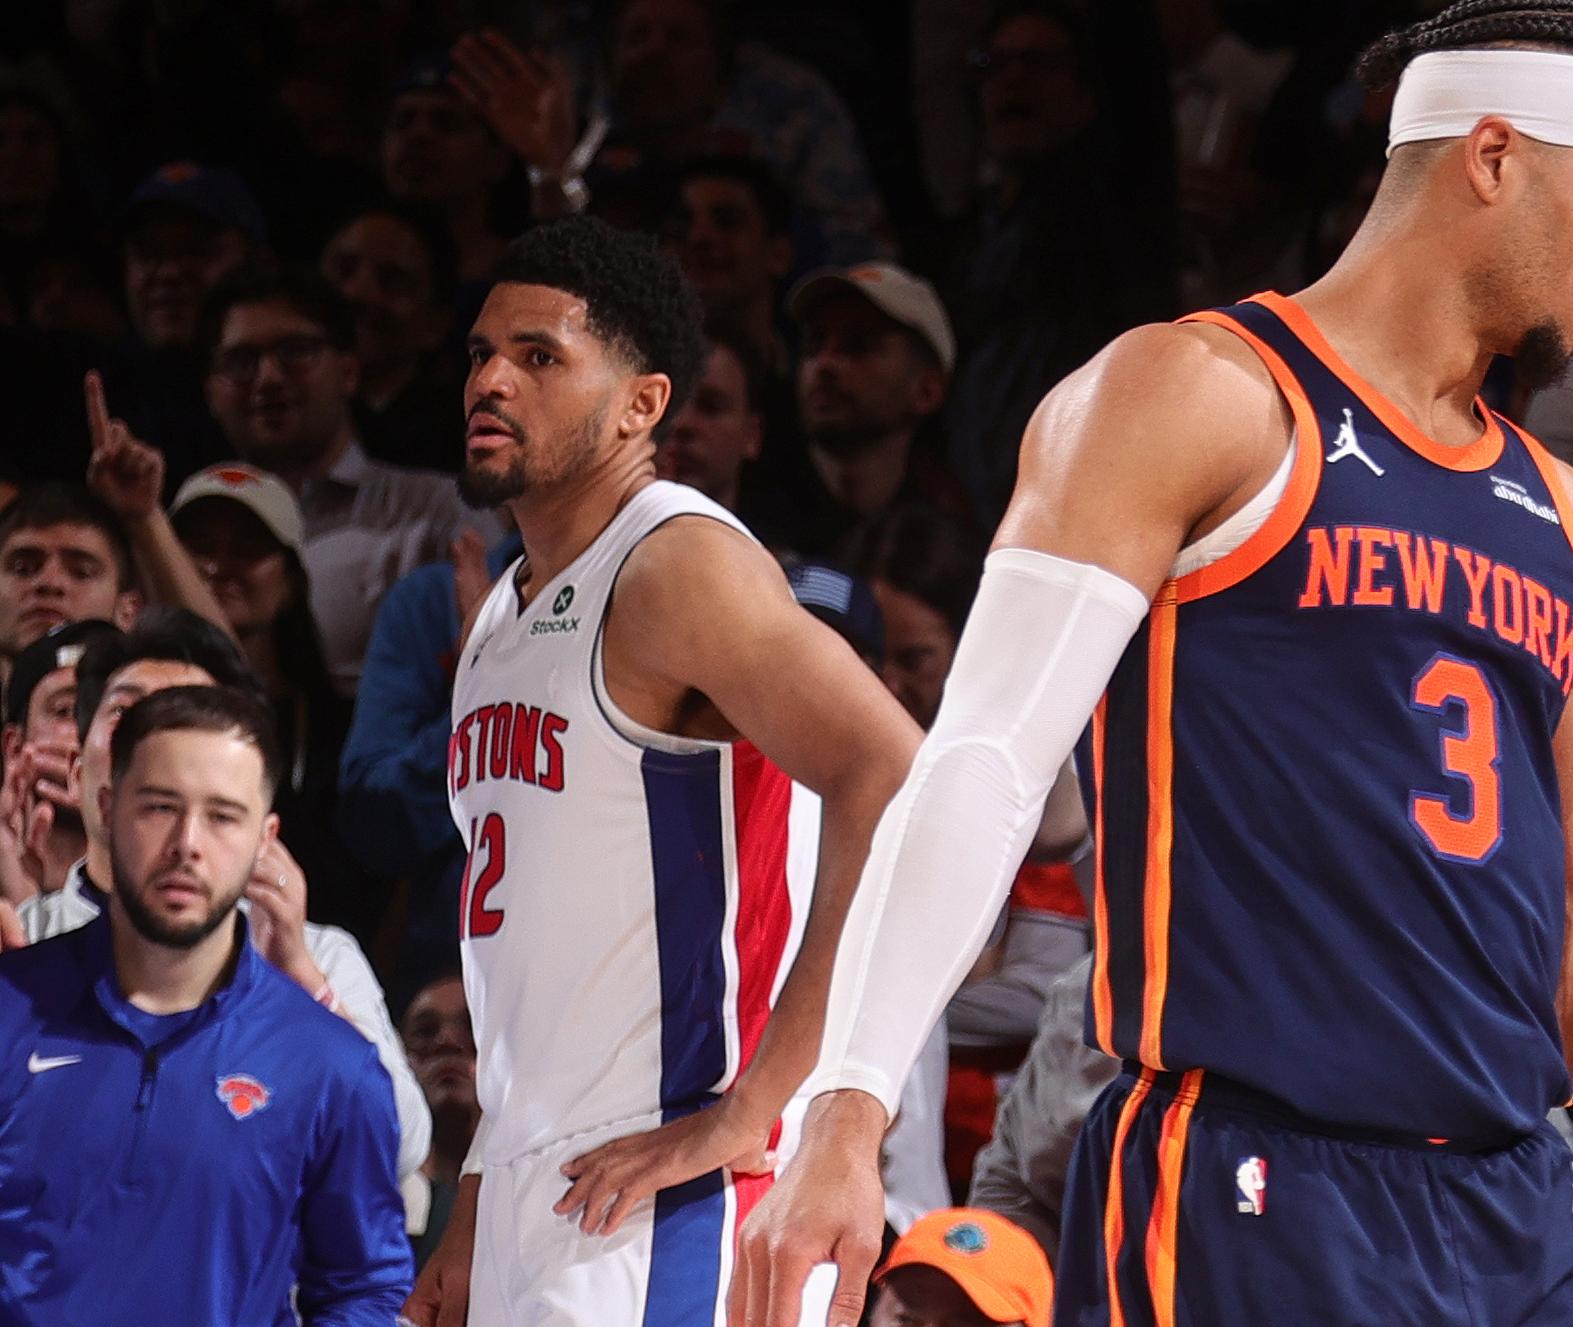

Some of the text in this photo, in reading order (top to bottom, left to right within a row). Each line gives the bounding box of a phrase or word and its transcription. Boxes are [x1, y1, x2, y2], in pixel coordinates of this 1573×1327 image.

[1299, 526, 1450, 614] NEW
[529, 616, 580, 636] StockX
[1408, 650, 1503, 867] 3
